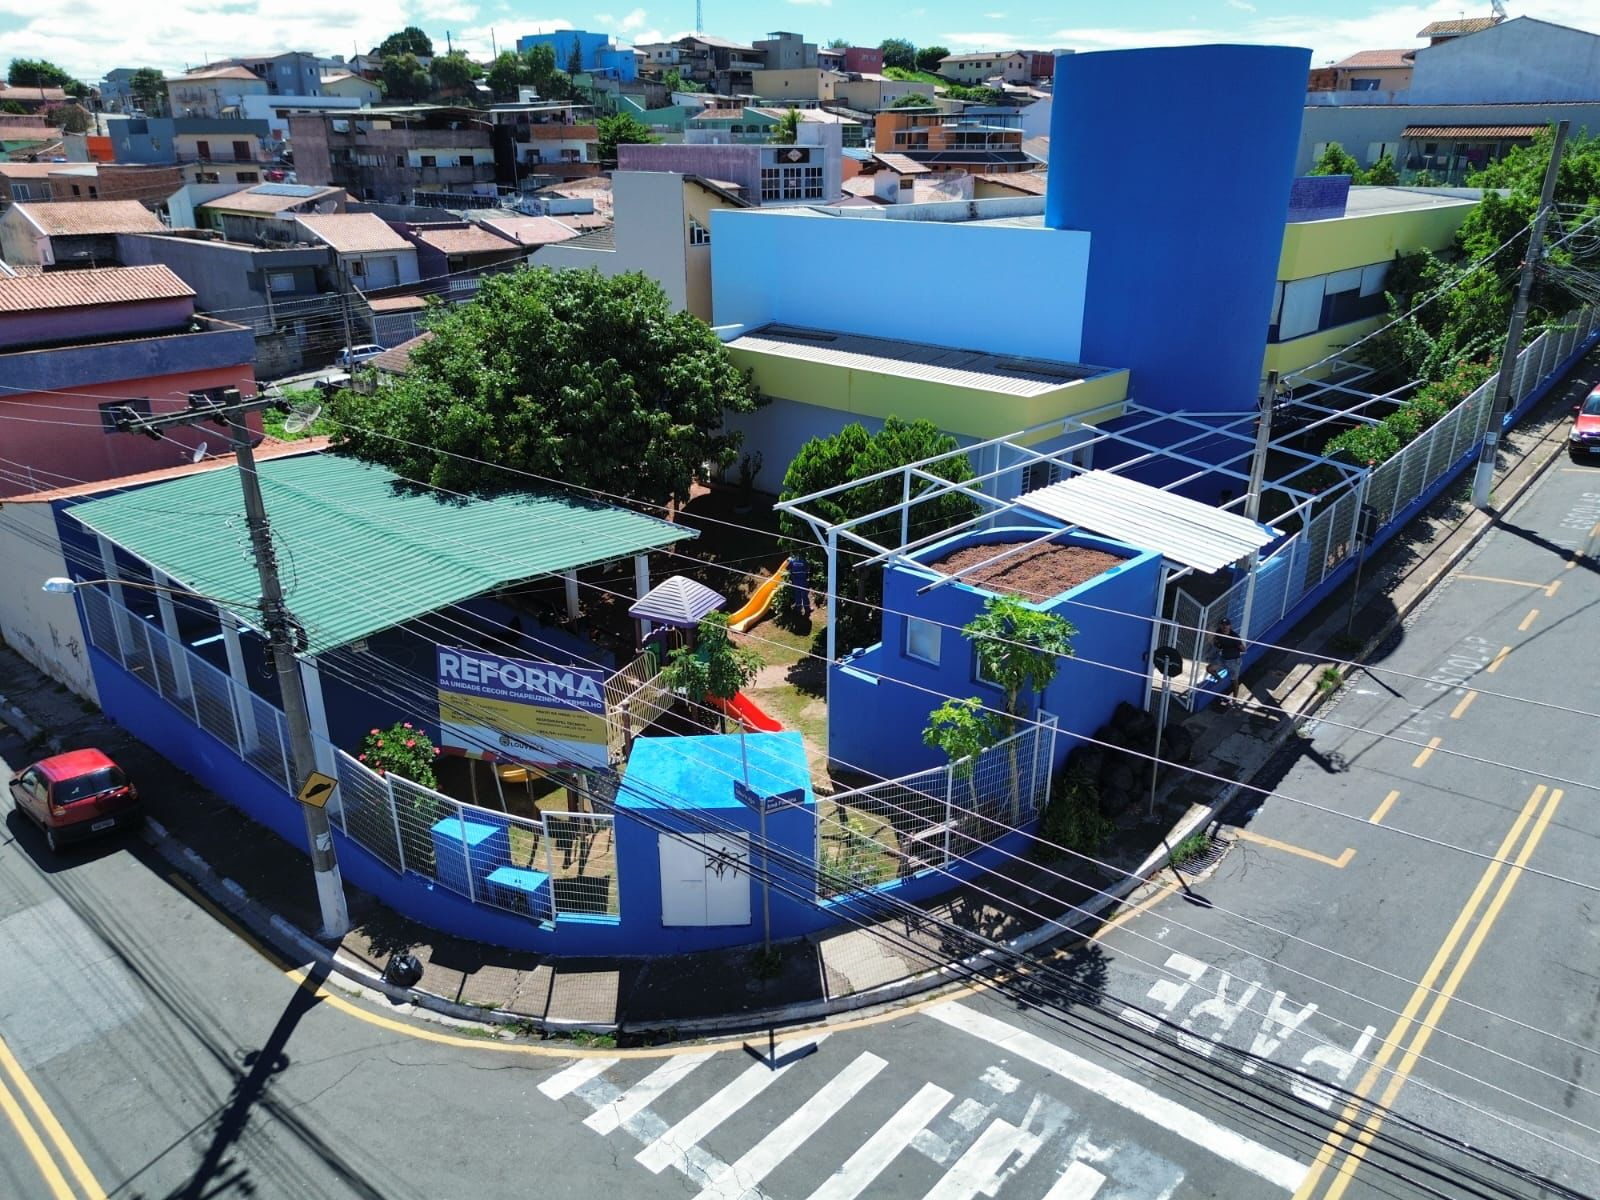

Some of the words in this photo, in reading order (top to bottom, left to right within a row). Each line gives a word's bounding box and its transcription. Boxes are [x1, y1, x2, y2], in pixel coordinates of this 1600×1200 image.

[439, 652, 602, 701] REFORMA
[450, 681, 481, 692] UNIDADE
[481, 686, 508, 696] CECOIN
[509, 690, 560, 704] CHAPEUZINHO
[561, 699, 602, 710] VERMELHO
[1118, 953, 1377, 1110] PARE
